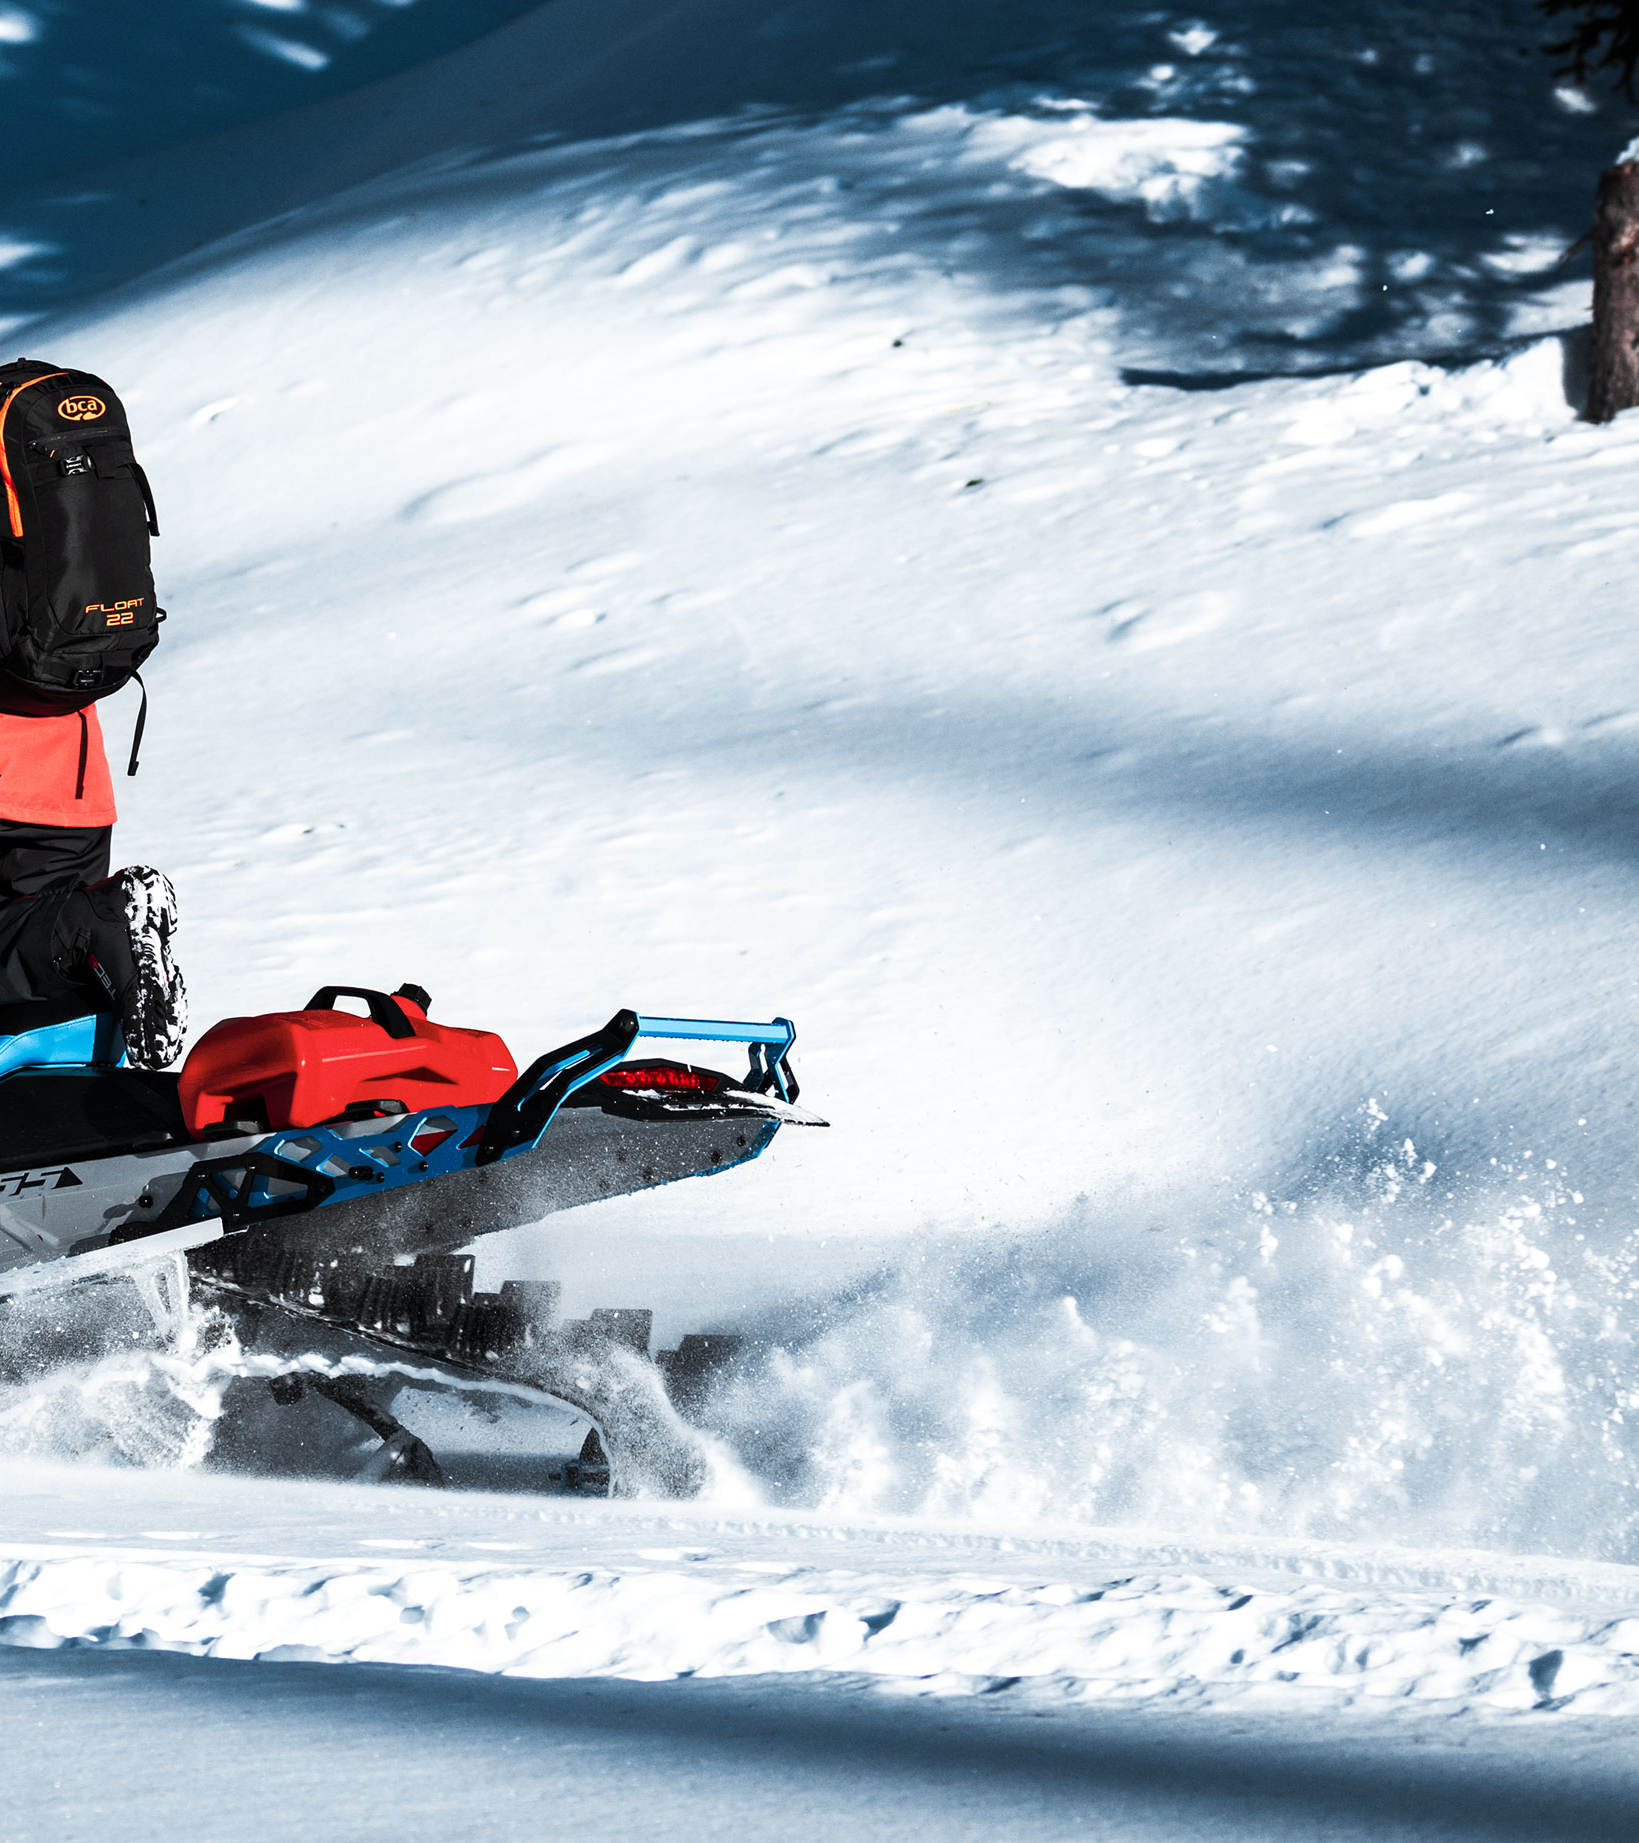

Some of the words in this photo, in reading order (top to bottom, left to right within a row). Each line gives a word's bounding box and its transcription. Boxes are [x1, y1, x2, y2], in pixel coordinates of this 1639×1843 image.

[64, 398, 98, 419] bca
[85, 597, 145, 614] FLOAT
[106, 611, 134, 627] 22
